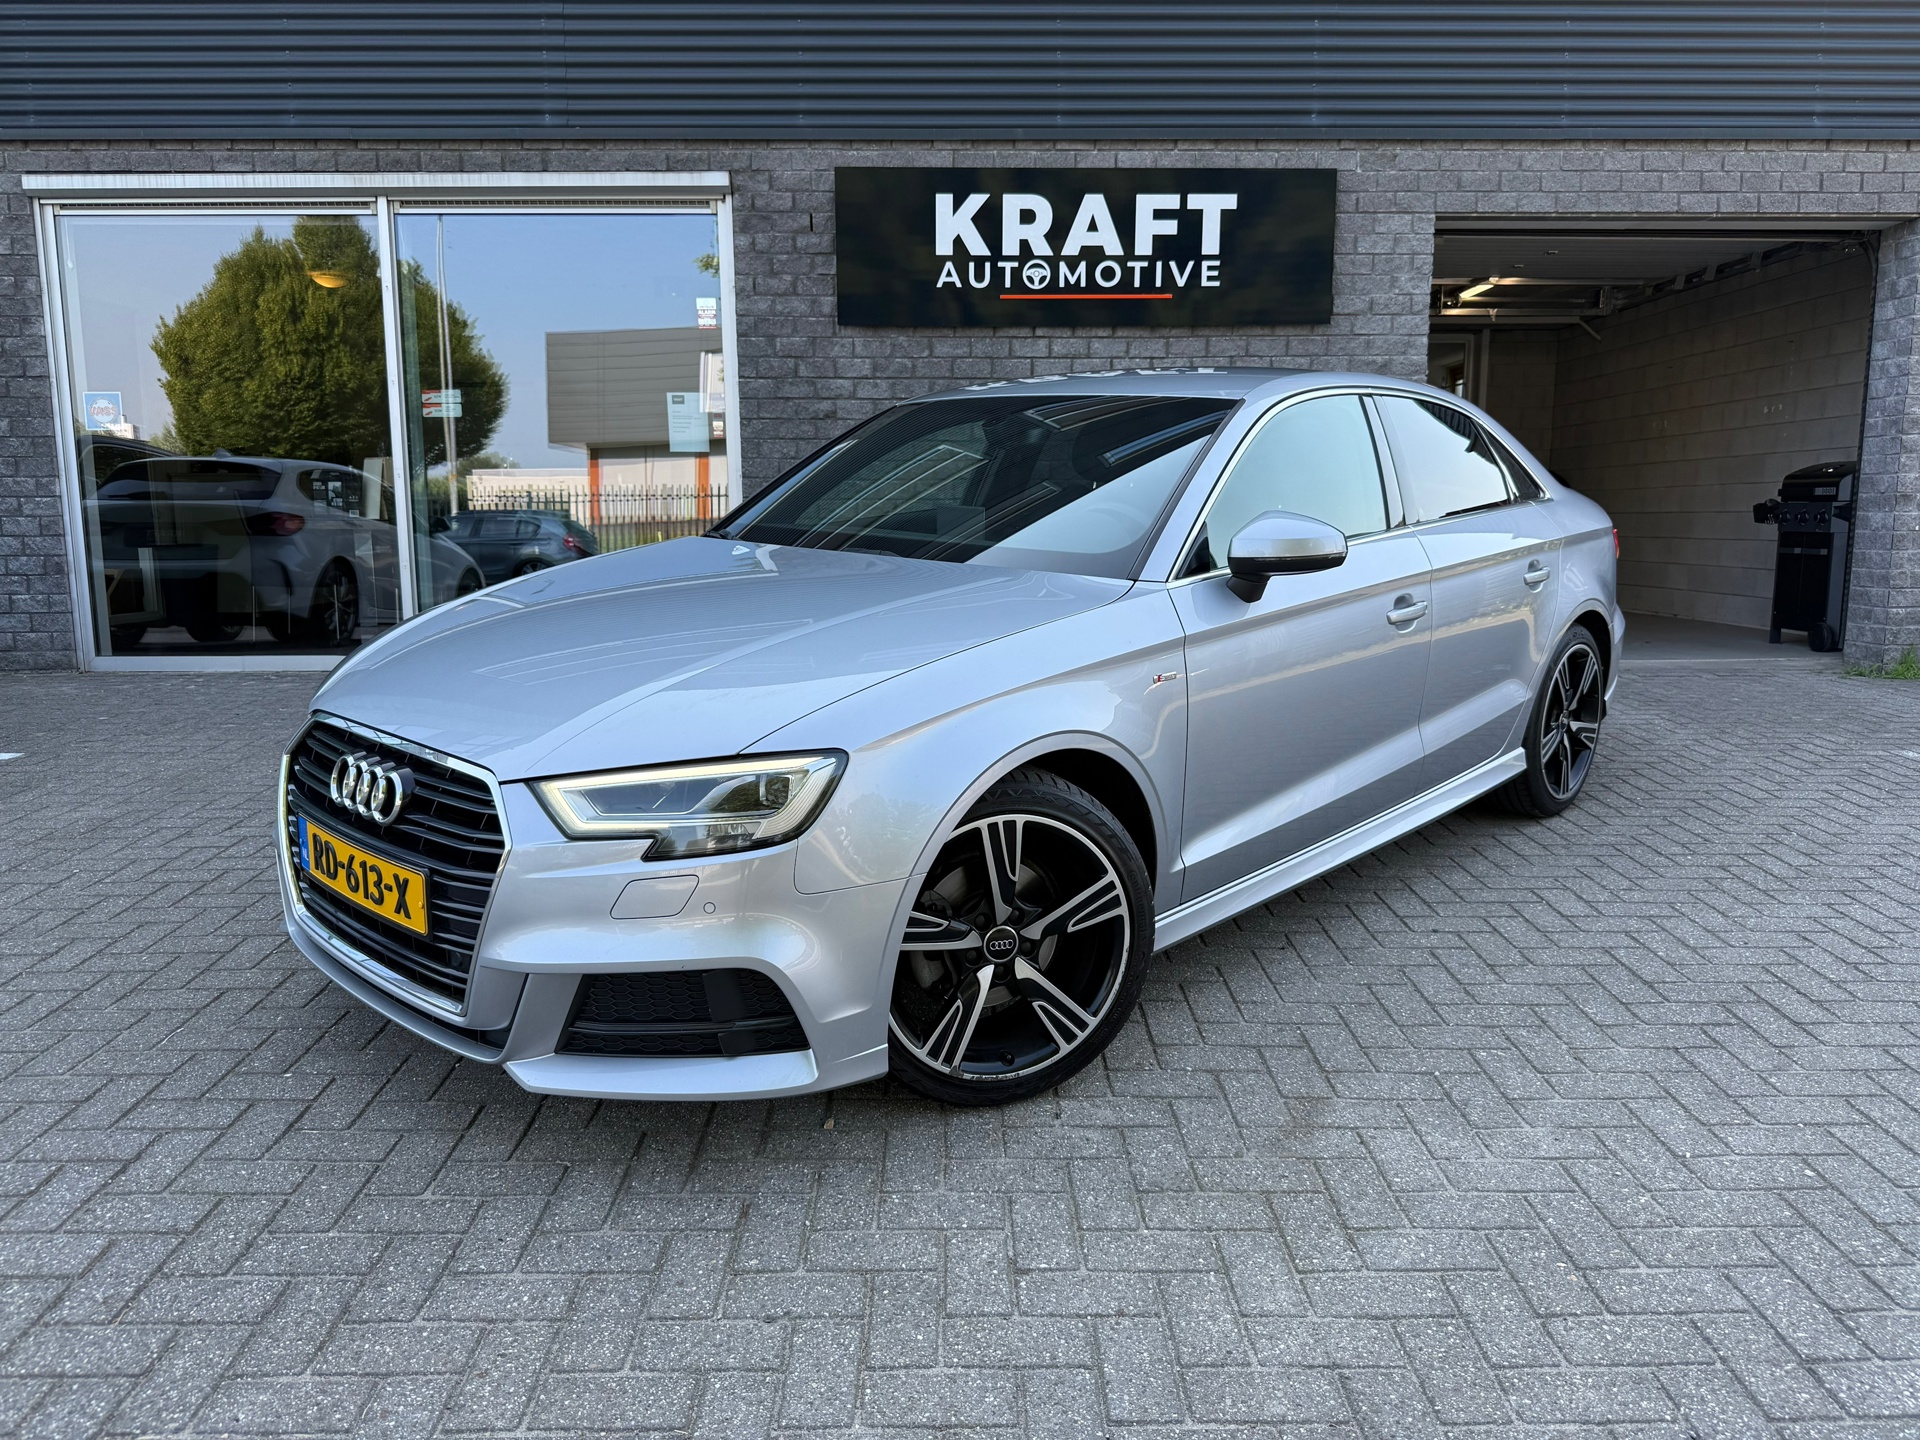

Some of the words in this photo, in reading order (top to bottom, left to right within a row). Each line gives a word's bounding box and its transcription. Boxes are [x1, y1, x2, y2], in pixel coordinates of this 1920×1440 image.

[935, 193, 1238, 256] KRAFT
[936, 259, 1221, 289] AUTOMOTIVE
[312, 833, 411, 919] RD-613-X
